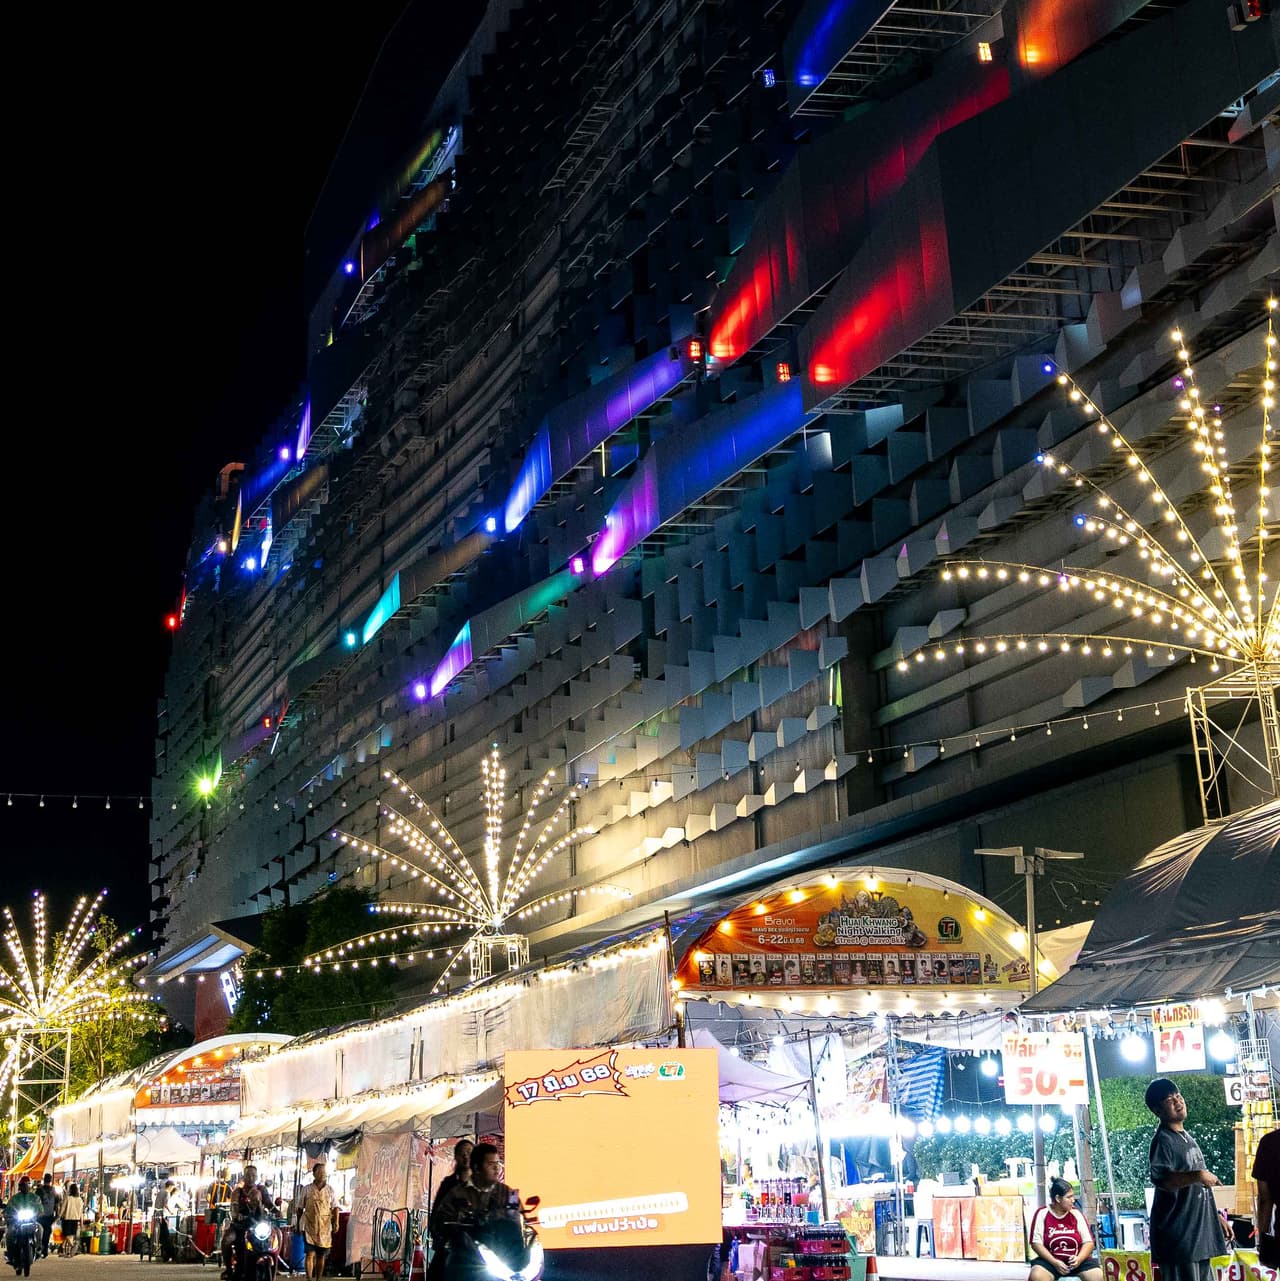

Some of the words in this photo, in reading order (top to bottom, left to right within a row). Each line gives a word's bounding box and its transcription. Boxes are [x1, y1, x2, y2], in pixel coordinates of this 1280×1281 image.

[764, 915, 793, 926] Bravo
[837, 926, 864, 937] Night
[865, 926, 903, 937] Walking
[835, 936, 860, 945] Street
[869, 936, 891, 945] Bravo
[891, 936, 906, 945] Bkk
[517, 1081, 540, 1099] 17
